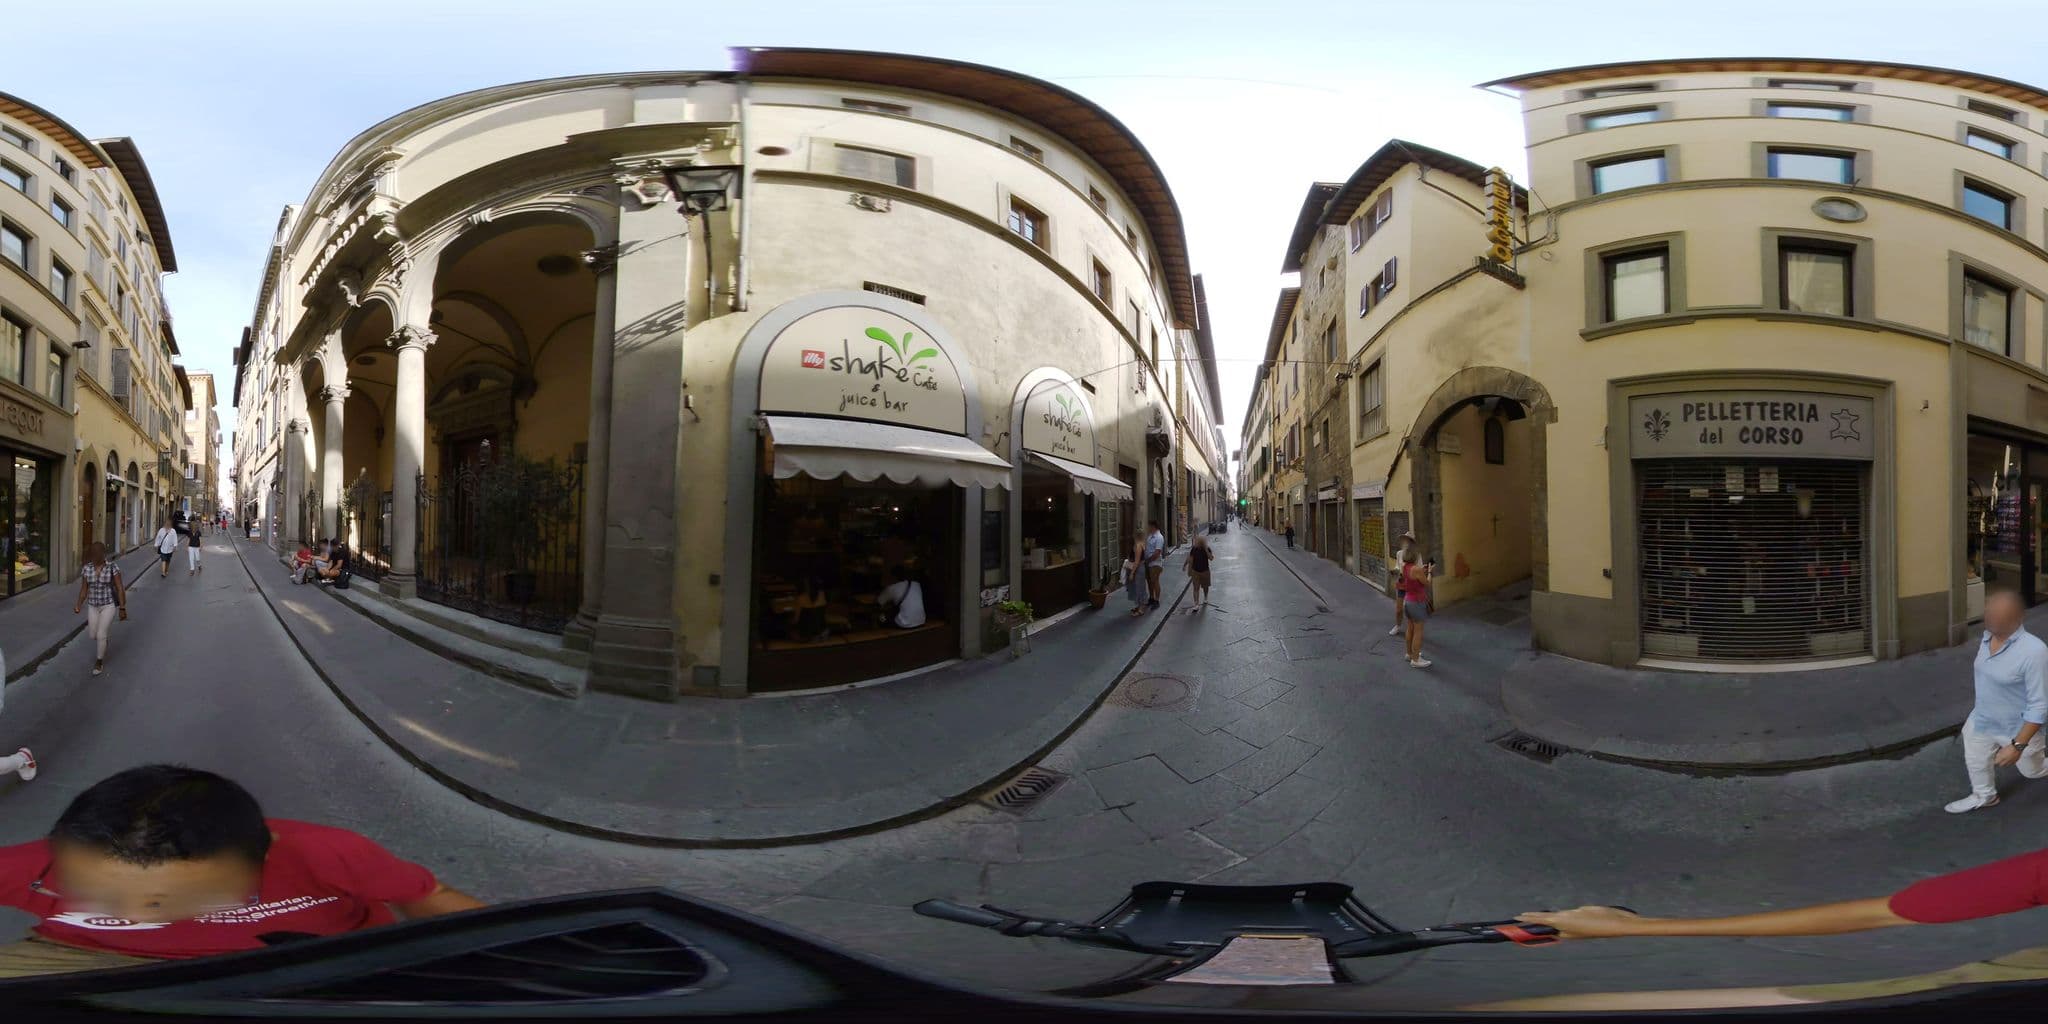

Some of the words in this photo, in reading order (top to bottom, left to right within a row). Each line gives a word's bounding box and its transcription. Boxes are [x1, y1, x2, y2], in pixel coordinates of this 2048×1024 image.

[802, 351, 825, 368] illy
[830, 339, 909, 383] shake
[871, 384, 881, 393] &
[839, 390, 877, 412] juice
[884, 392, 908, 412] bar
[1682, 401, 1819, 423] PELLETTERIA
[1043, 400, 1072, 432] shake
[1699, 427, 1723, 444] del
[1738, 426, 1804, 445] CORSO
